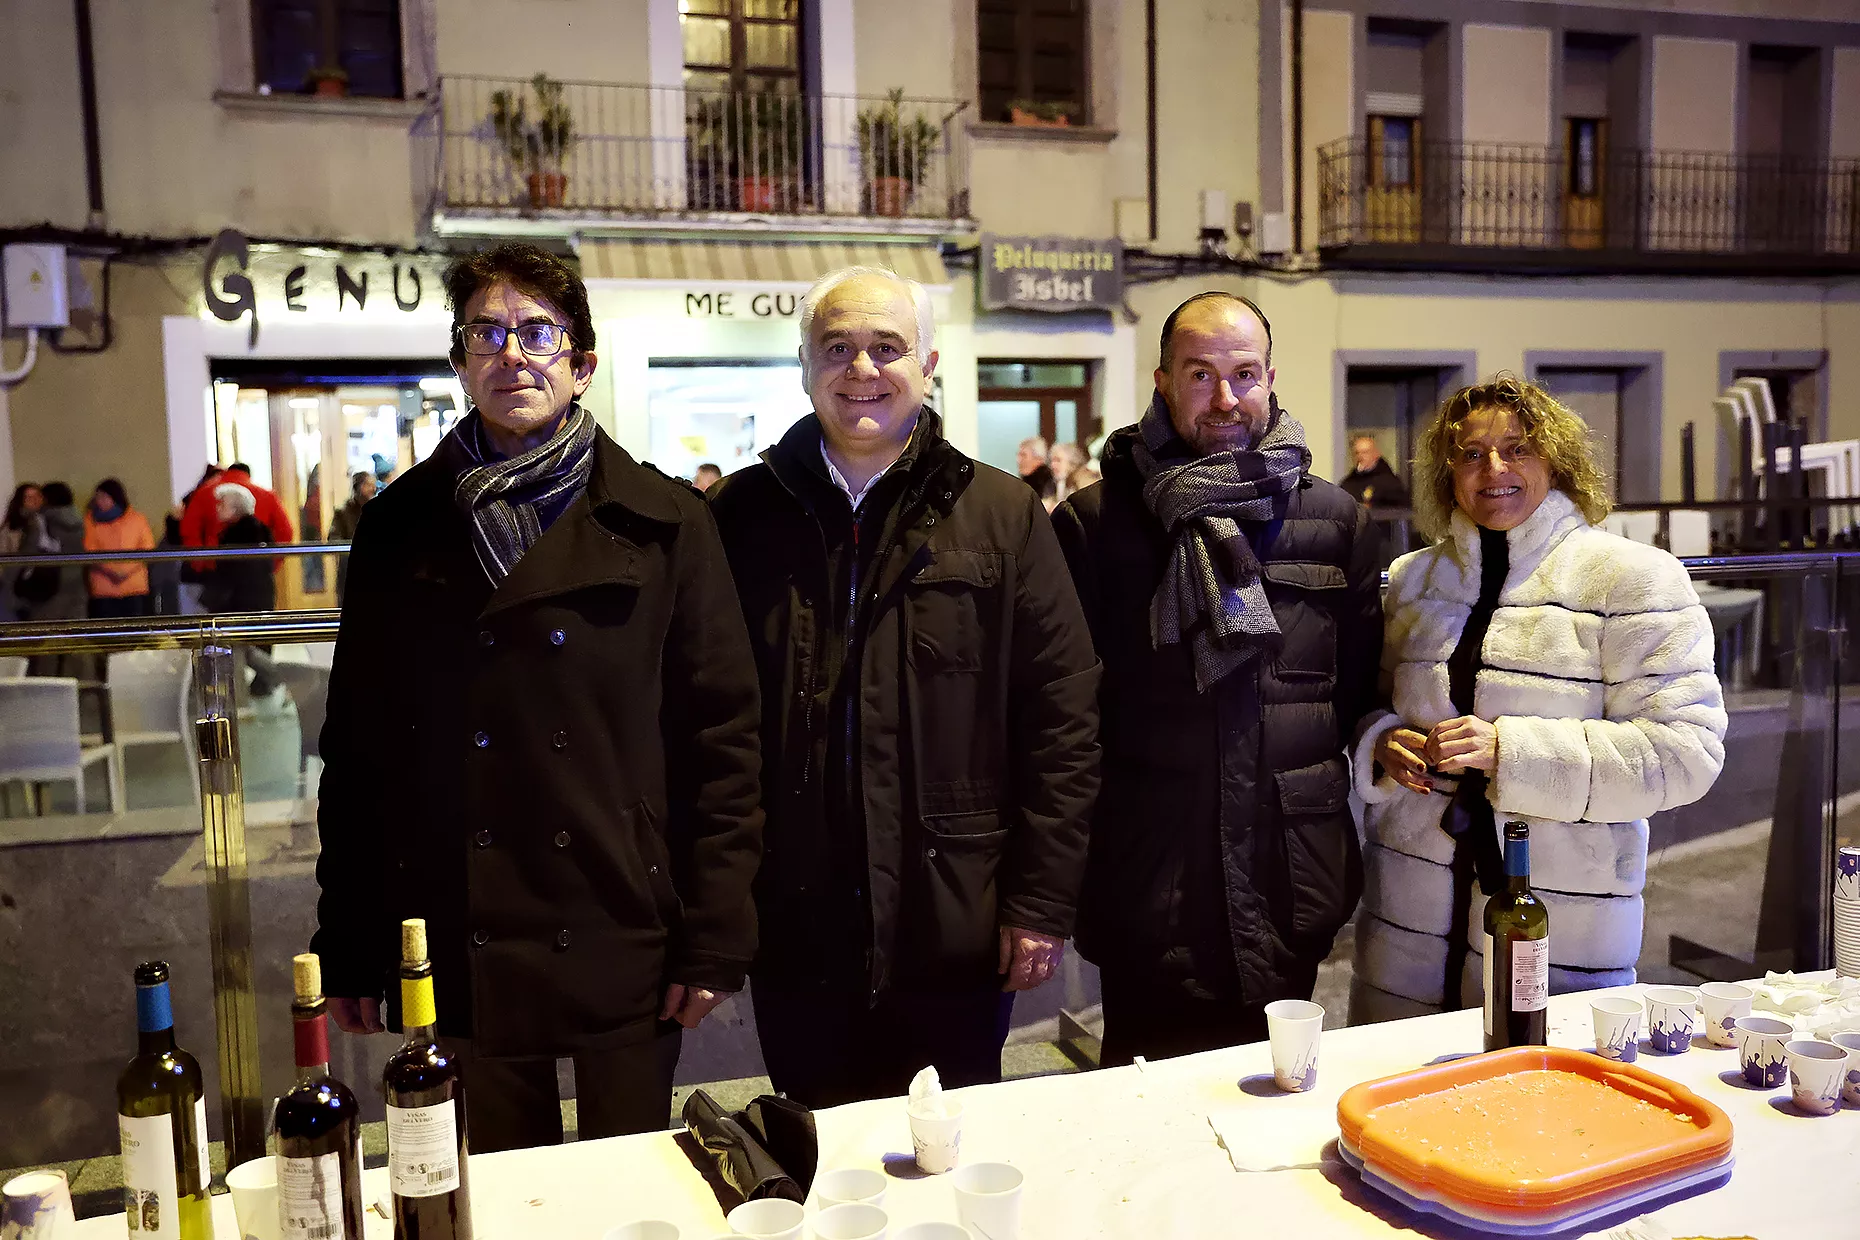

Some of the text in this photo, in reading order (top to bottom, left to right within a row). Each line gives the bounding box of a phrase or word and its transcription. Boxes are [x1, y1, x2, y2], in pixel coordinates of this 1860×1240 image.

[204, 229, 446, 350] GENU
[686, 292, 805, 316] ME GU
